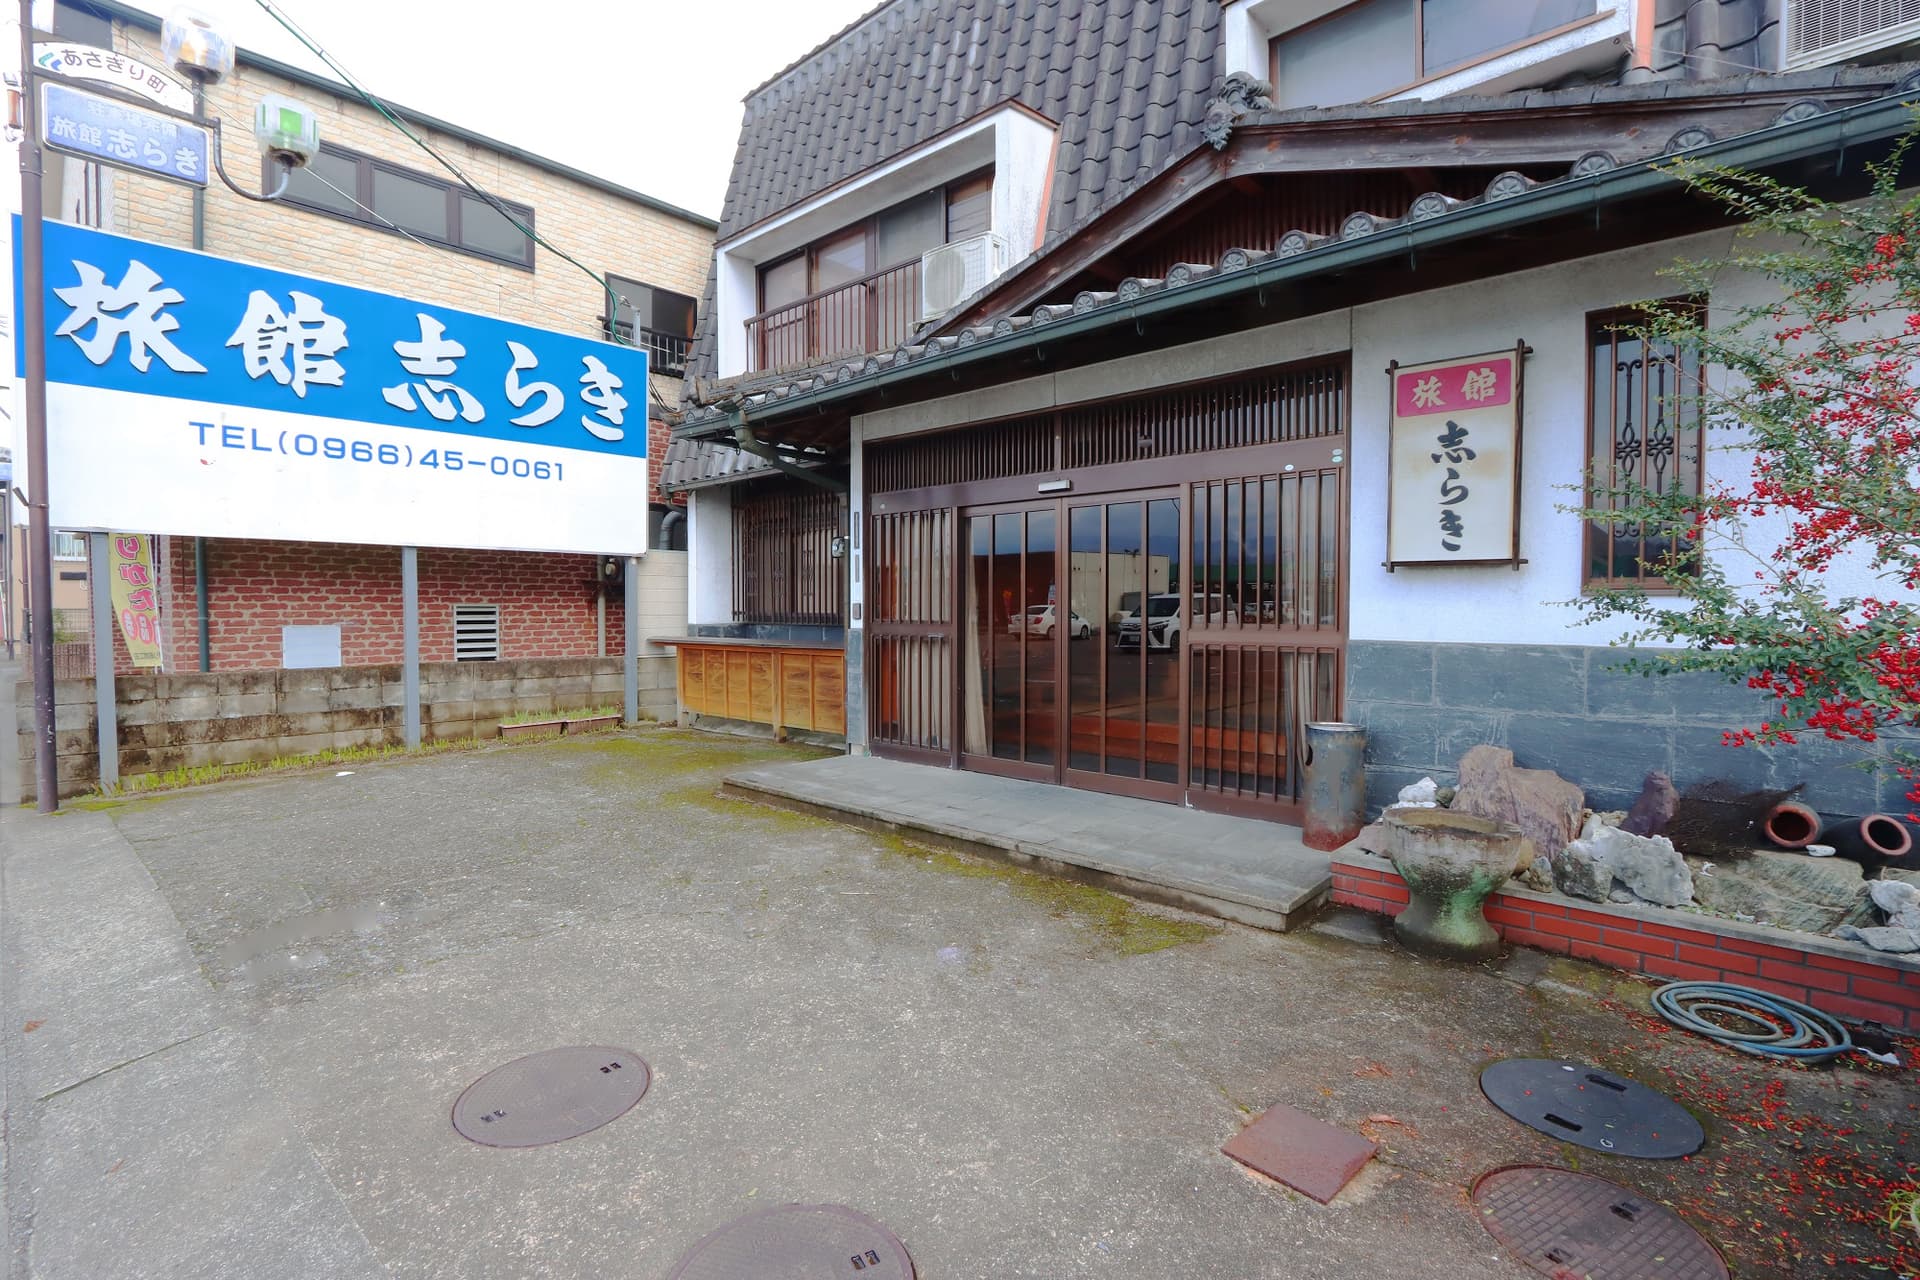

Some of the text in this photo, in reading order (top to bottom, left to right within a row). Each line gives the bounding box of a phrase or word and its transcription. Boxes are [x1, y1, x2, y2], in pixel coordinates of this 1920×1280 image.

[62, 49, 166, 94] あさぎり町
[52, 115, 200, 177] 旅館志らき
[1411, 368, 1497, 408] 旅館
[1430, 420, 1478, 552] 志らき
